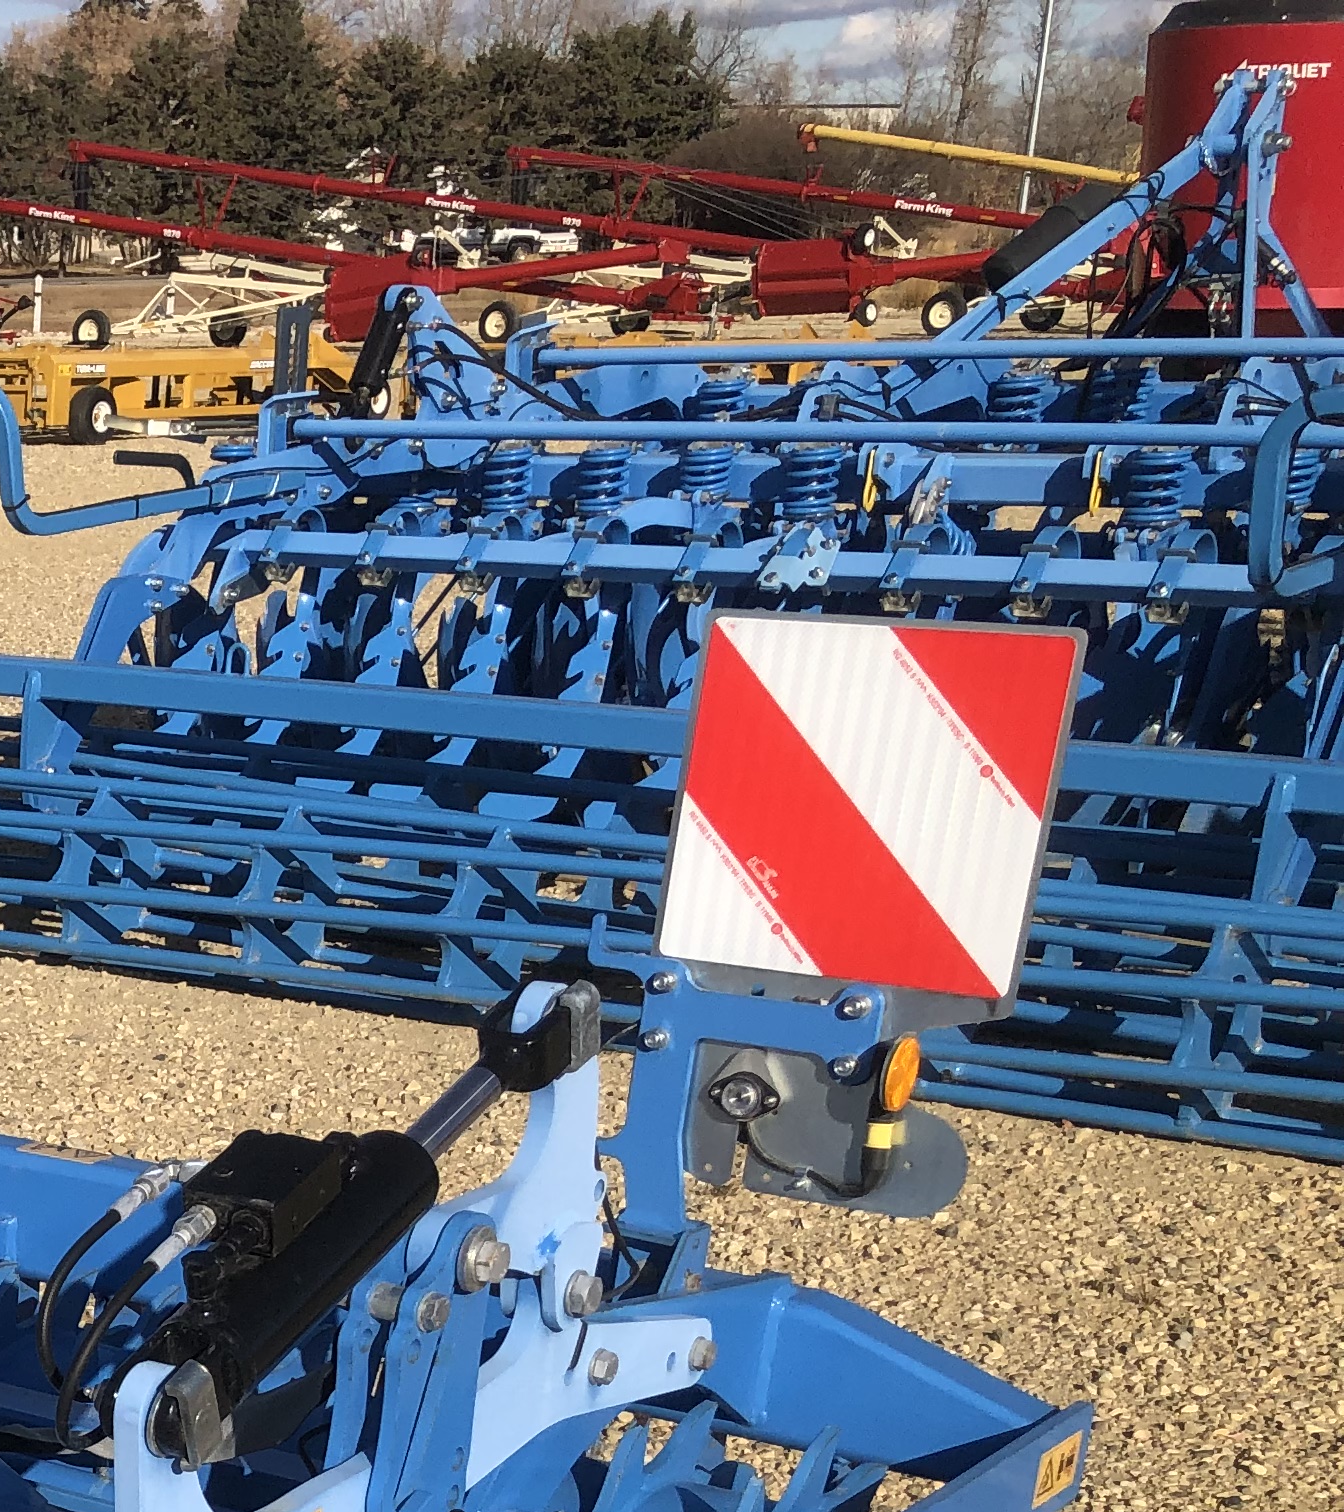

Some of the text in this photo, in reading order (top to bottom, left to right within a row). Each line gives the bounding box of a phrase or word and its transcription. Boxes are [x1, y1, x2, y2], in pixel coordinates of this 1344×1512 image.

[425, 197, 476, 213] Farm King
[894, 199, 954, 218] Farm King
[28, 207, 75, 223] Farm King
